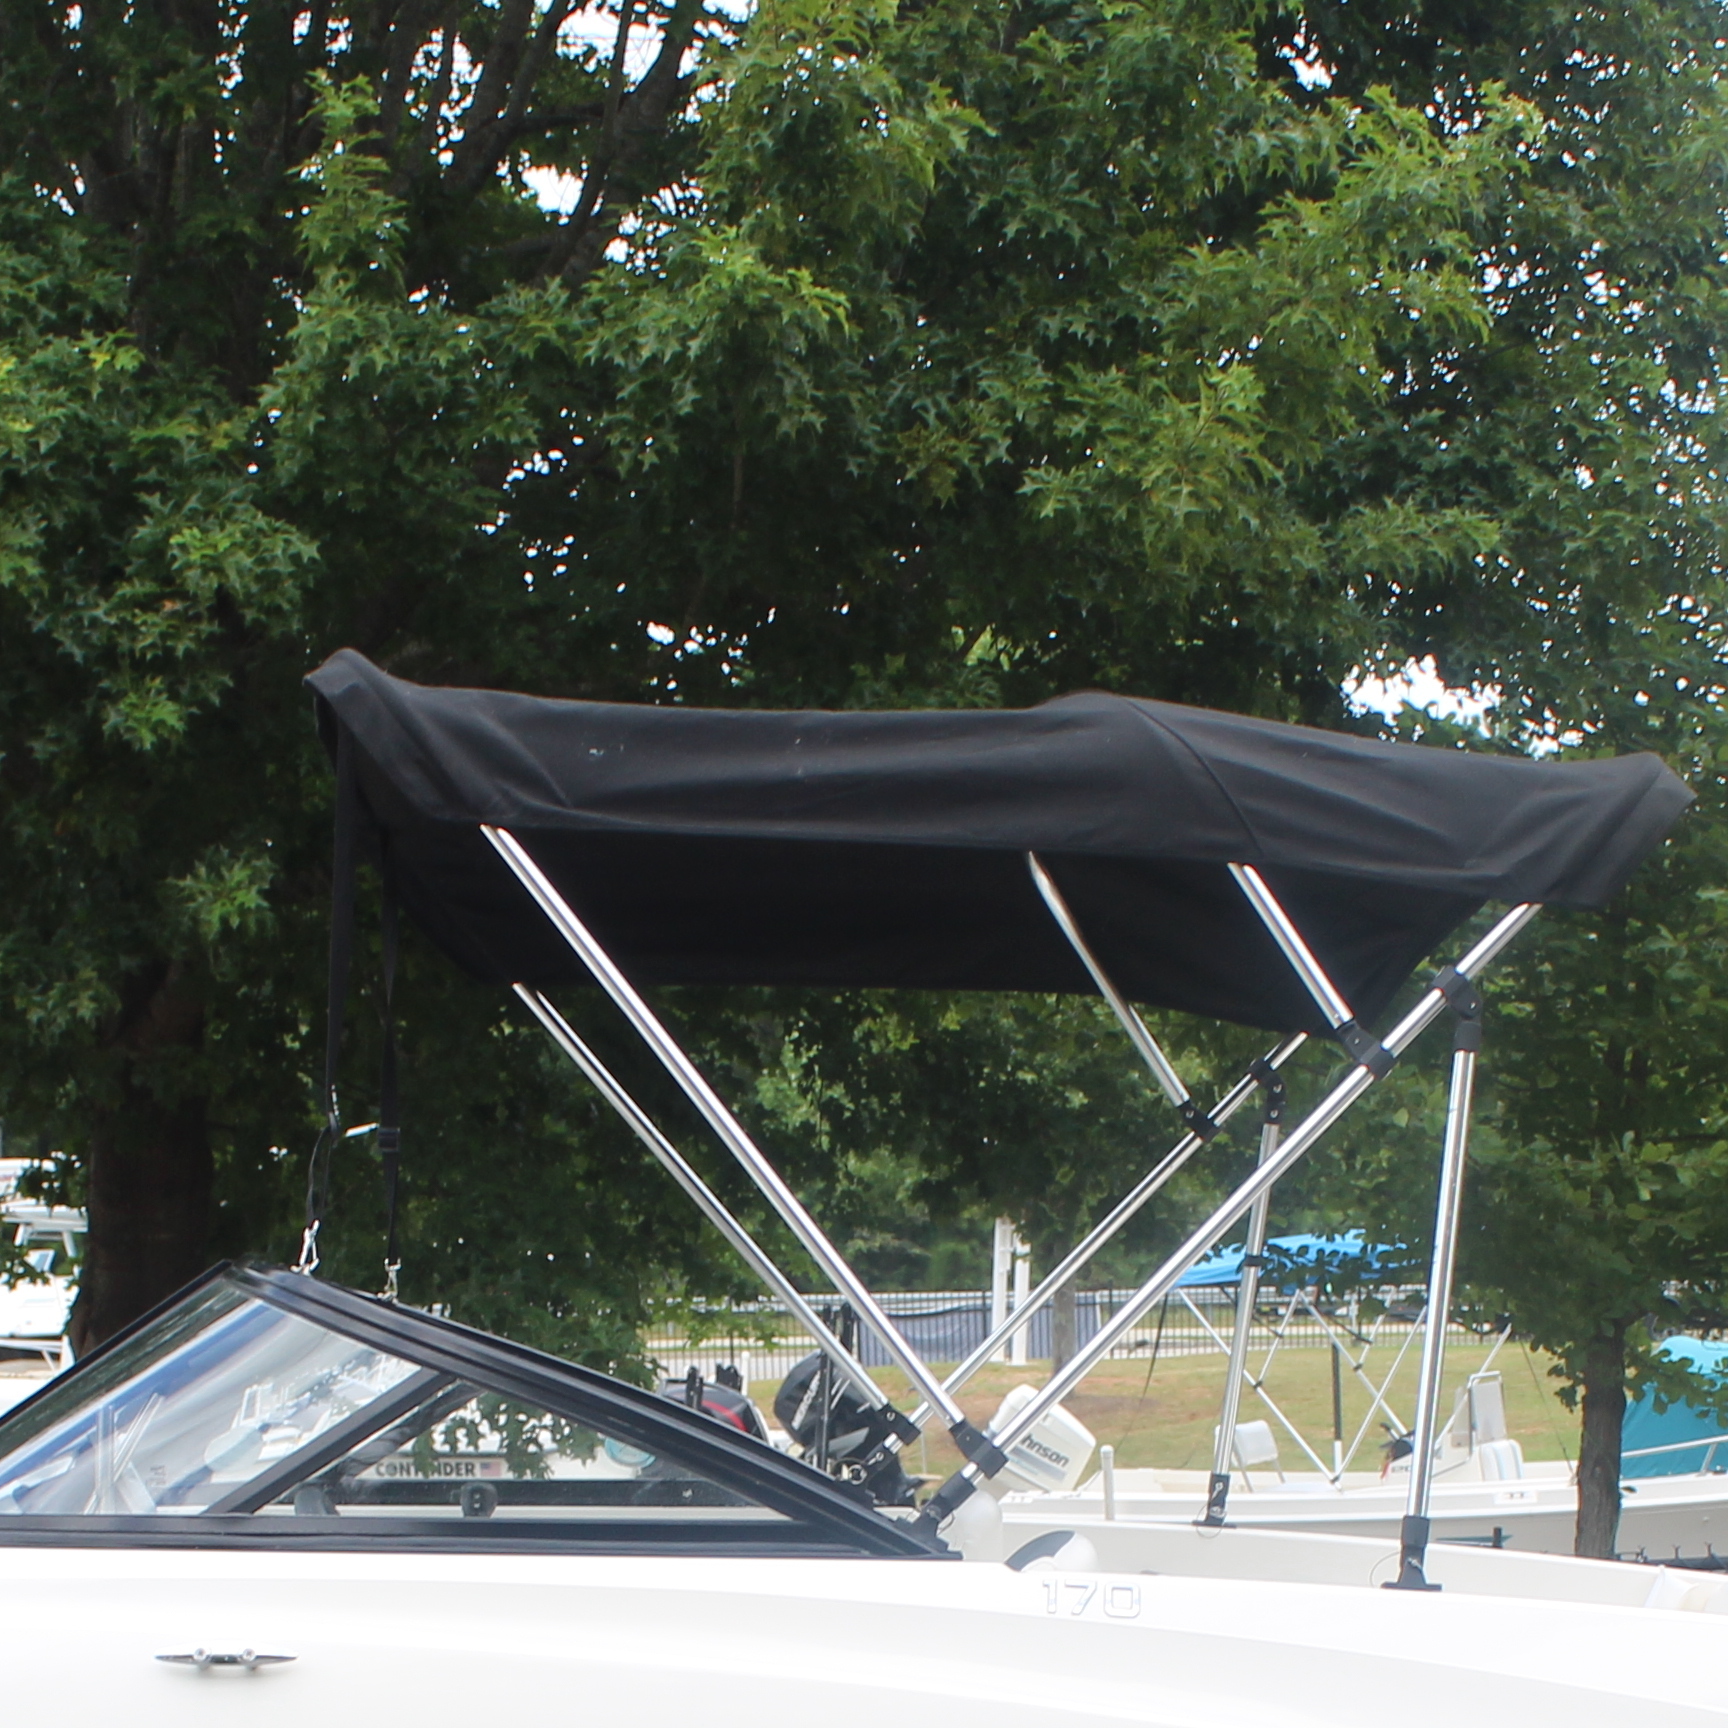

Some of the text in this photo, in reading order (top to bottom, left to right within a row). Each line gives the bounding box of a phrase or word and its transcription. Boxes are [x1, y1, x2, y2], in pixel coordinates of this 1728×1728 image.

[1021, 1433, 1070, 1468] hnson
[375, 1461, 476, 1477] CONTNDER
[1042, 1579, 1141, 1620] 170
